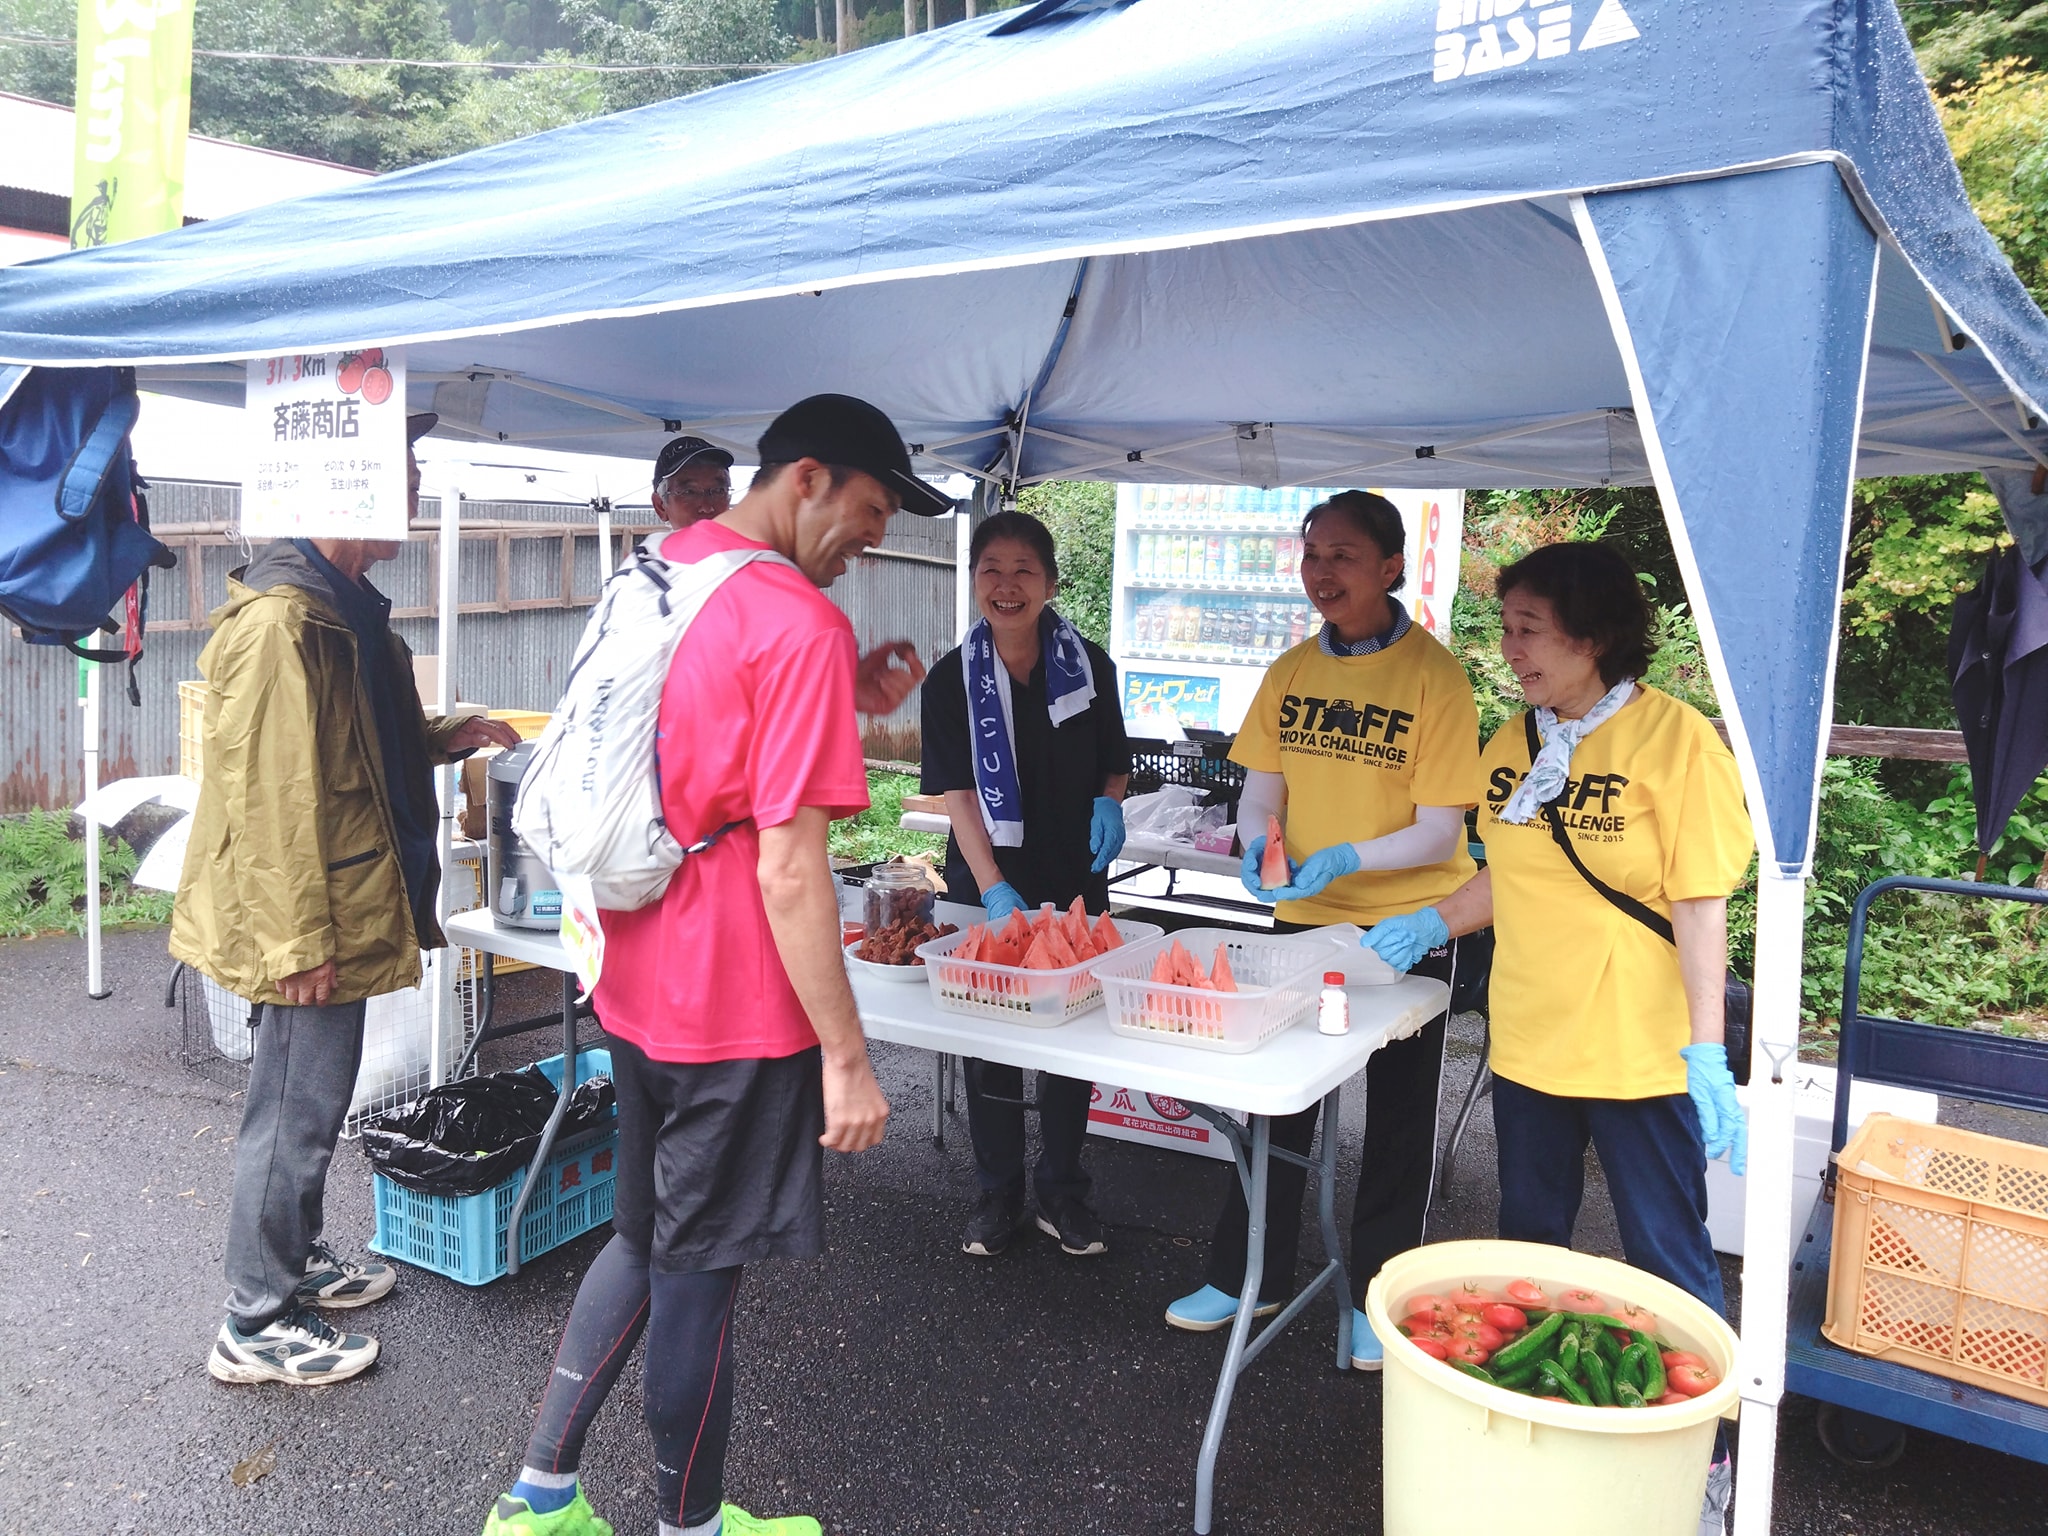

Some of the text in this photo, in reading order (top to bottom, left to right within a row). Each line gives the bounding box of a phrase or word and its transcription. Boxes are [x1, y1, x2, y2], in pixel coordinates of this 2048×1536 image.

[1433, 4, 1573, 83] BASE
[273, 397, 360, 442] 斉藤商店
[1279, 695, 1415, 745] STAFF
[1320, 734, 1408, 764] CHALLENGE
[1335, 753, 1356, 762] WALK
[1363, 758, 1383, 768] SINCE
[1384, 762, 1402, 771] 2015
[1577, 832, 1600, 842] SINCE
[1602, 834, 1625, 843] 2015
[1122, 1117, 1199, 1139] 尾花沢西瓜出荷組合
